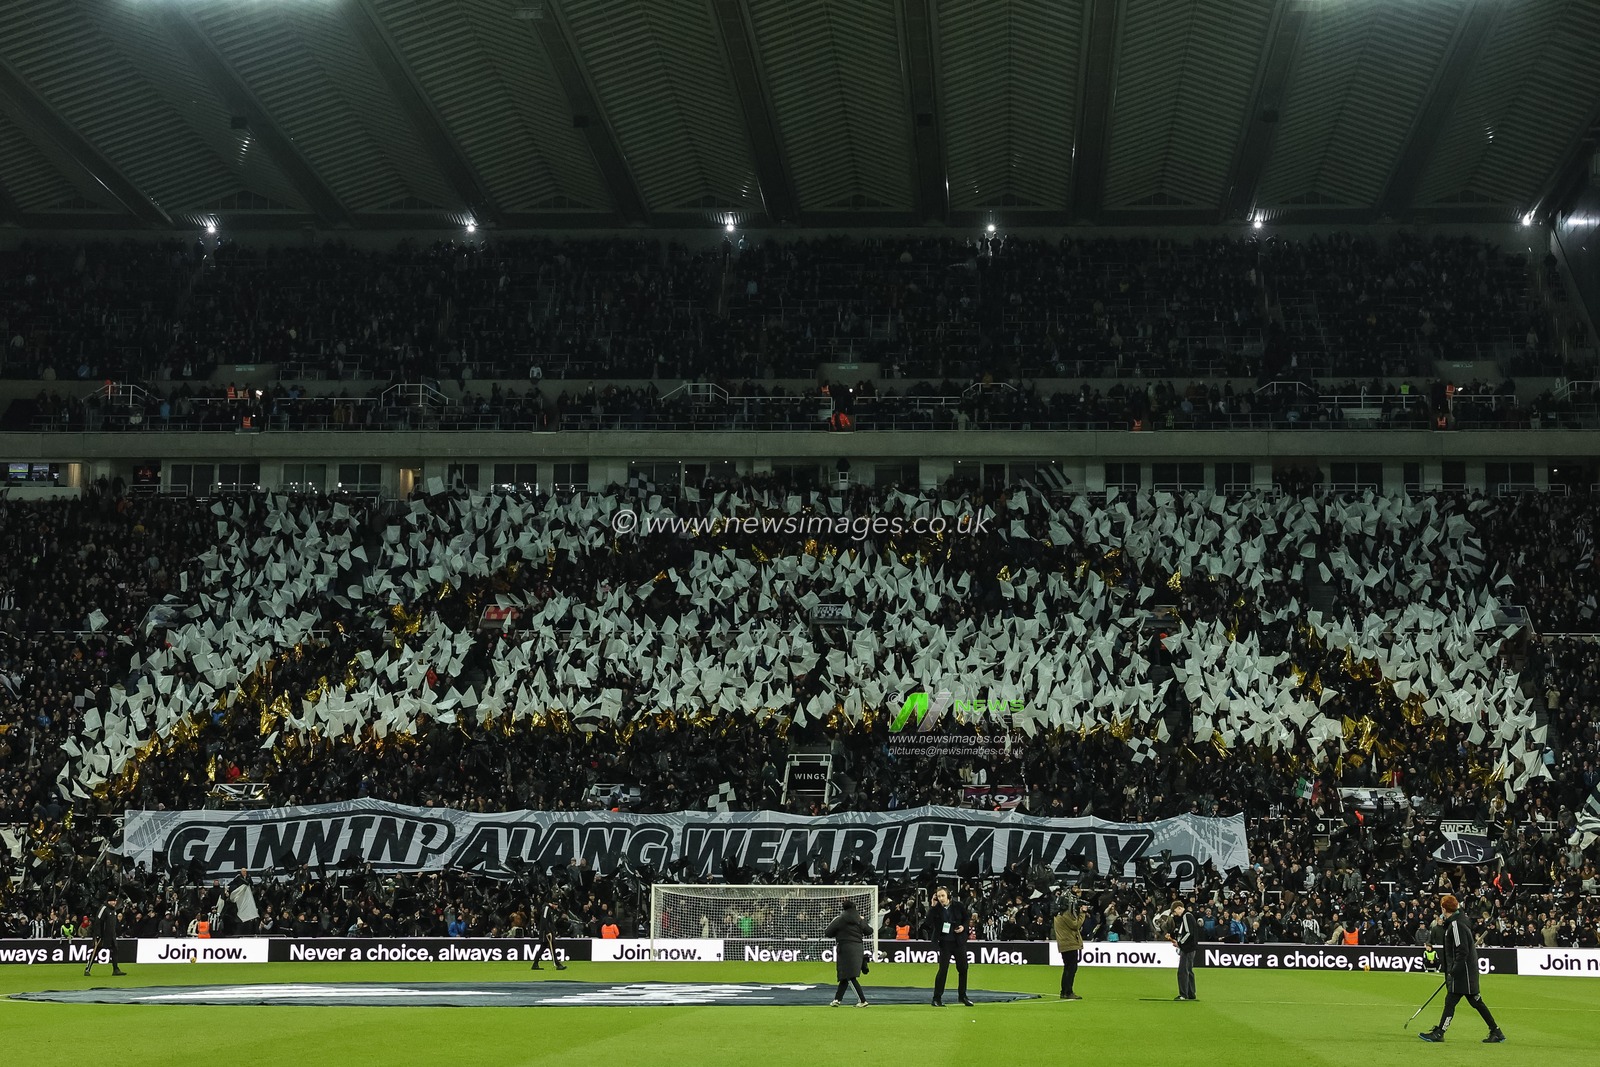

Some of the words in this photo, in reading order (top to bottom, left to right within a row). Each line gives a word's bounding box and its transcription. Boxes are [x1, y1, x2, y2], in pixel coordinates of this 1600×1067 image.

[684, 822, 996, 878] WEMBLEY
[1005, 828, 1149, 877] WAY
[0, 949, 48, 964] ways
[52, 948, 64, 961] a
[158, 943, 197, 960] Join
[203, 947, 247, 960] now.
[289, 944, 346, 961] Never
[350, 948, 362, 961] a
[366, 943, 434, 963] choice,
[438, 944, 502, 963] always
[507, 948, 519, 961] a
[613, 944, 651, 960] Join
[657, 948, 702, 960] now.
[744, 945, 800, 962] Never
[980, 947, 1028, 965] Mag.
[1116, 951, 1162, 965] now.
[1204, 949, 1263, 967] Never
[1266, 953, 1279, 968] a
[1283, 950, 1354, 970] choice,
[1358, 951, 1424, 972] always
[1539, 953, 1582, 970] Join
